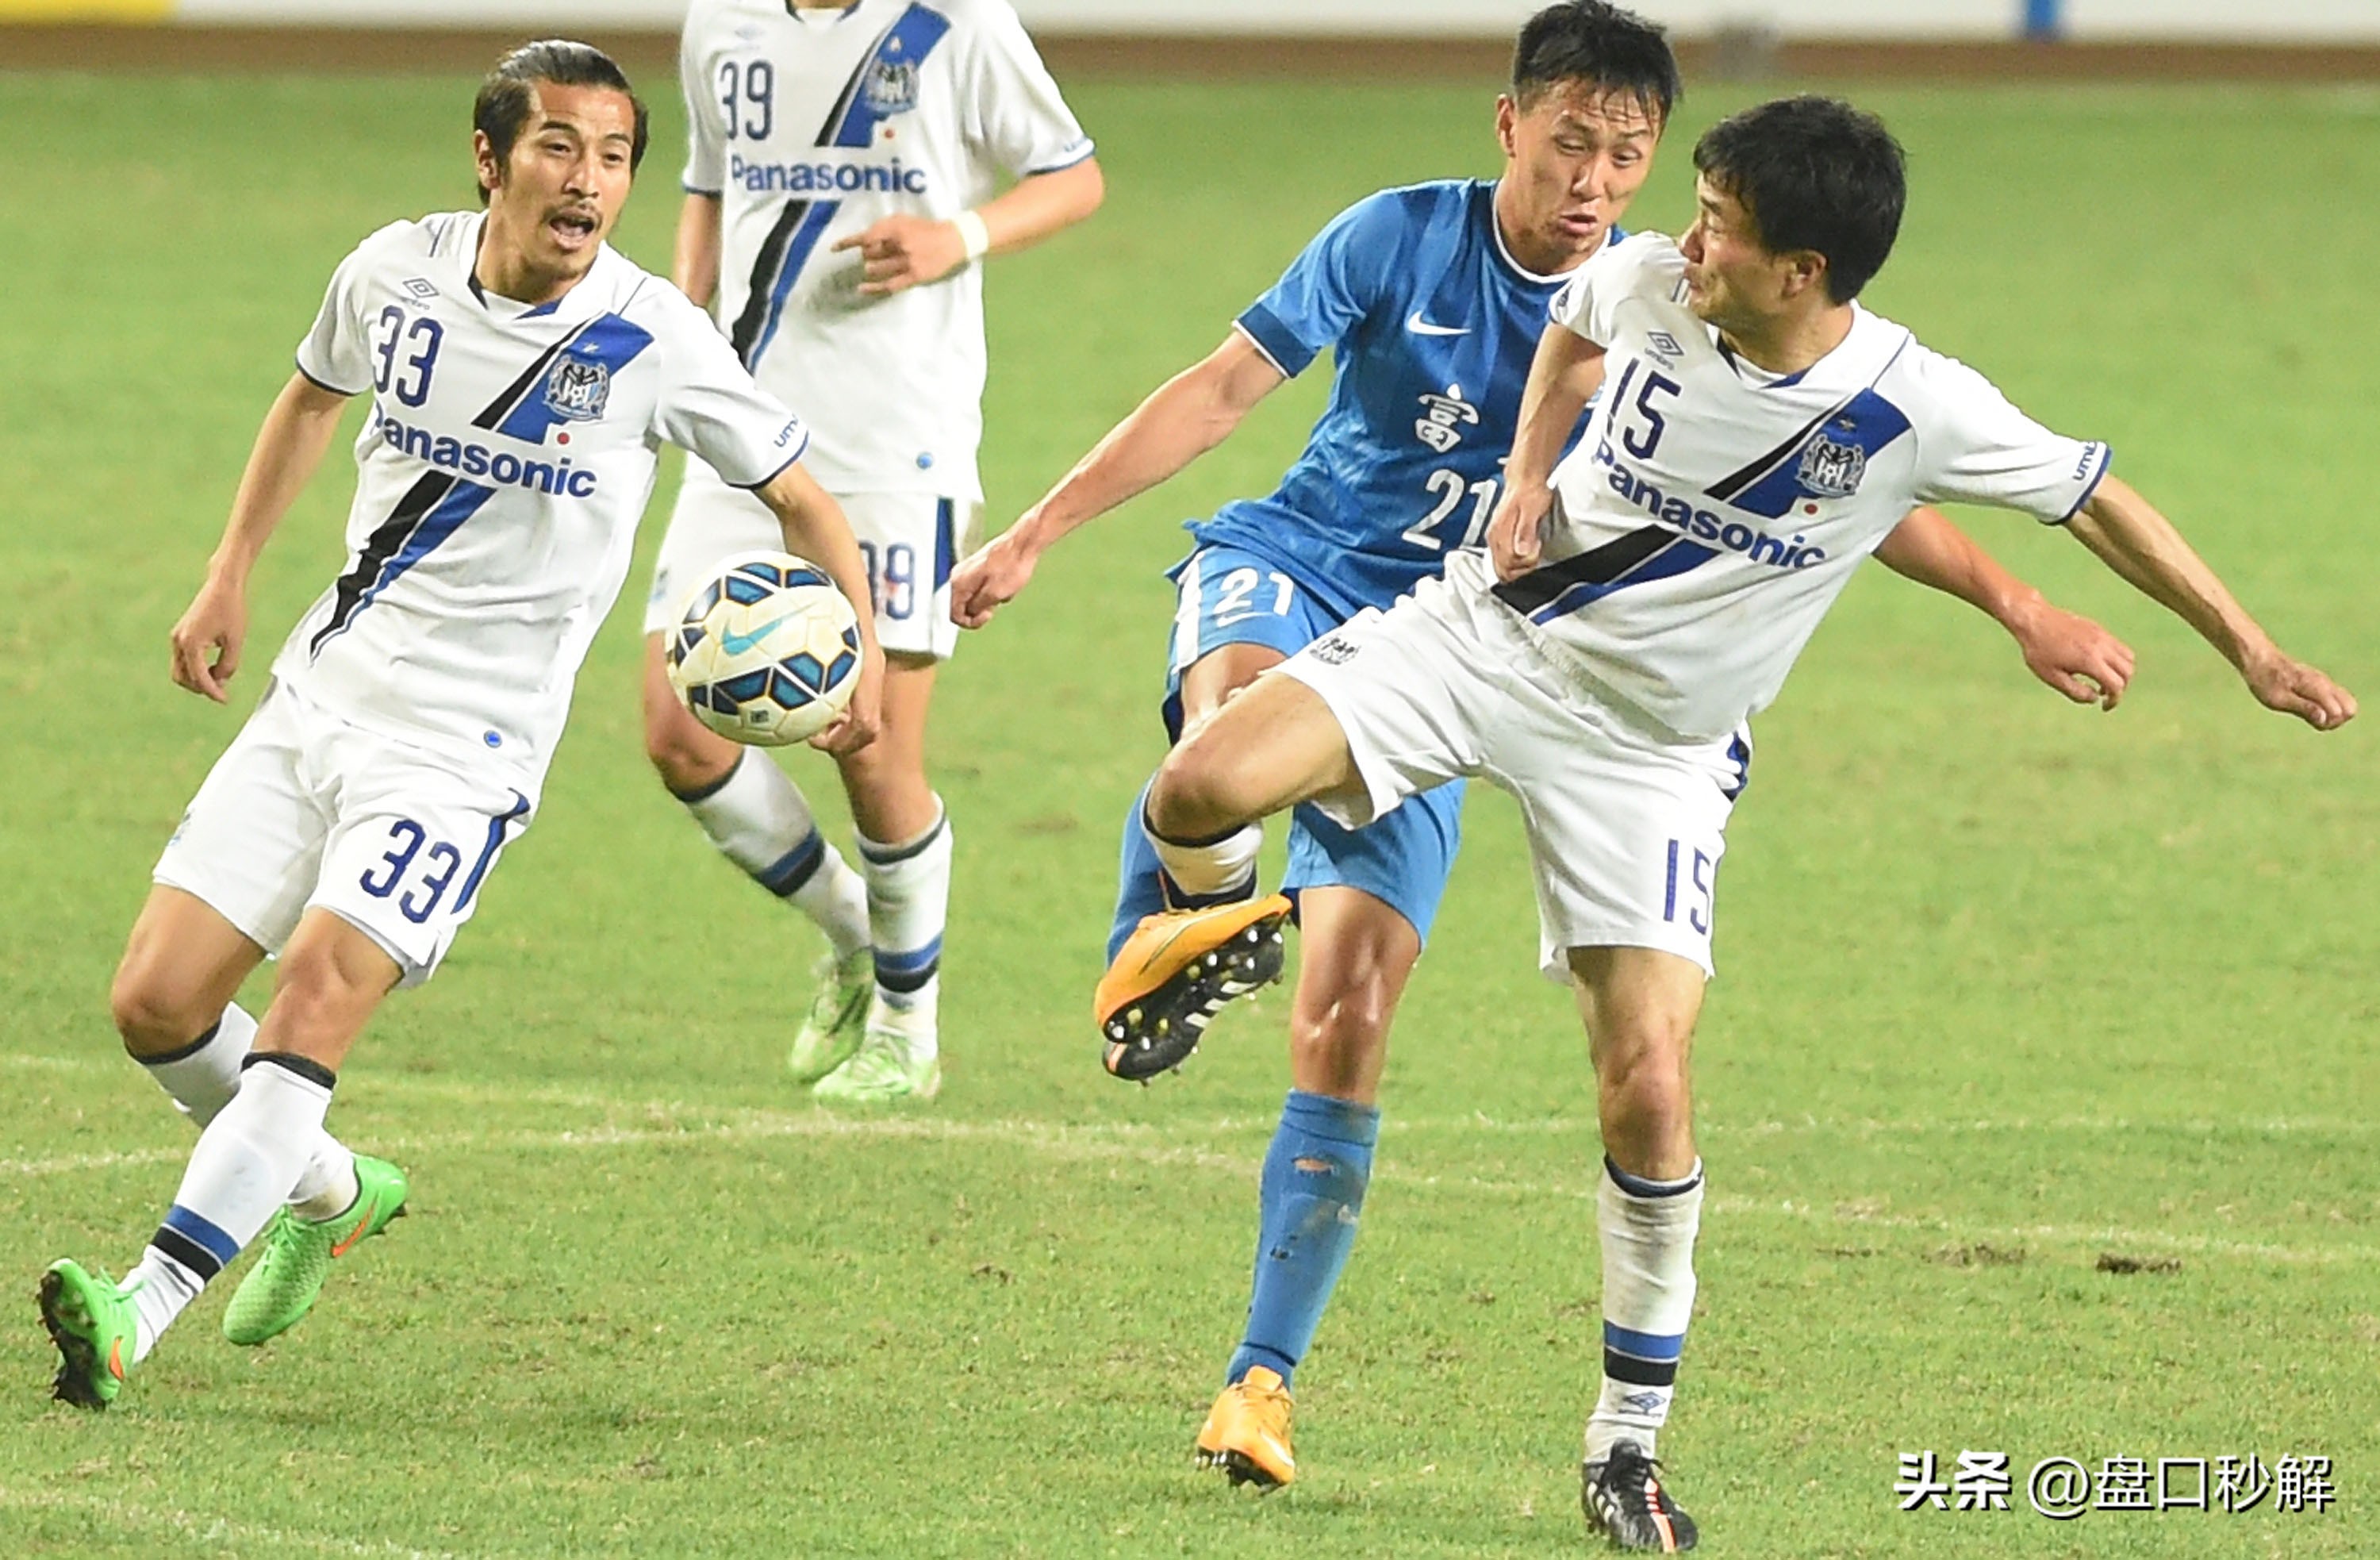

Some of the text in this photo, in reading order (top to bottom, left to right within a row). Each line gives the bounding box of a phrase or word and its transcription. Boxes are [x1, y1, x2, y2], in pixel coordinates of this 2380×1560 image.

[720, 60, 774, 140] 39
[731, 154, 927, 194] Panasonic
[373, 305, 444, 407] 33
[1415, 383, 1479, 453] 富
[1606, 357, 1682, 459] 15
[1402, 469, 1498, 550] 21
[1591, 435, 1825, 569] Panasonic
[1213, 567, 1295, 617] 21
[359, 819, 462, 924] 33
[1663, 838, 1710, 936] 15
